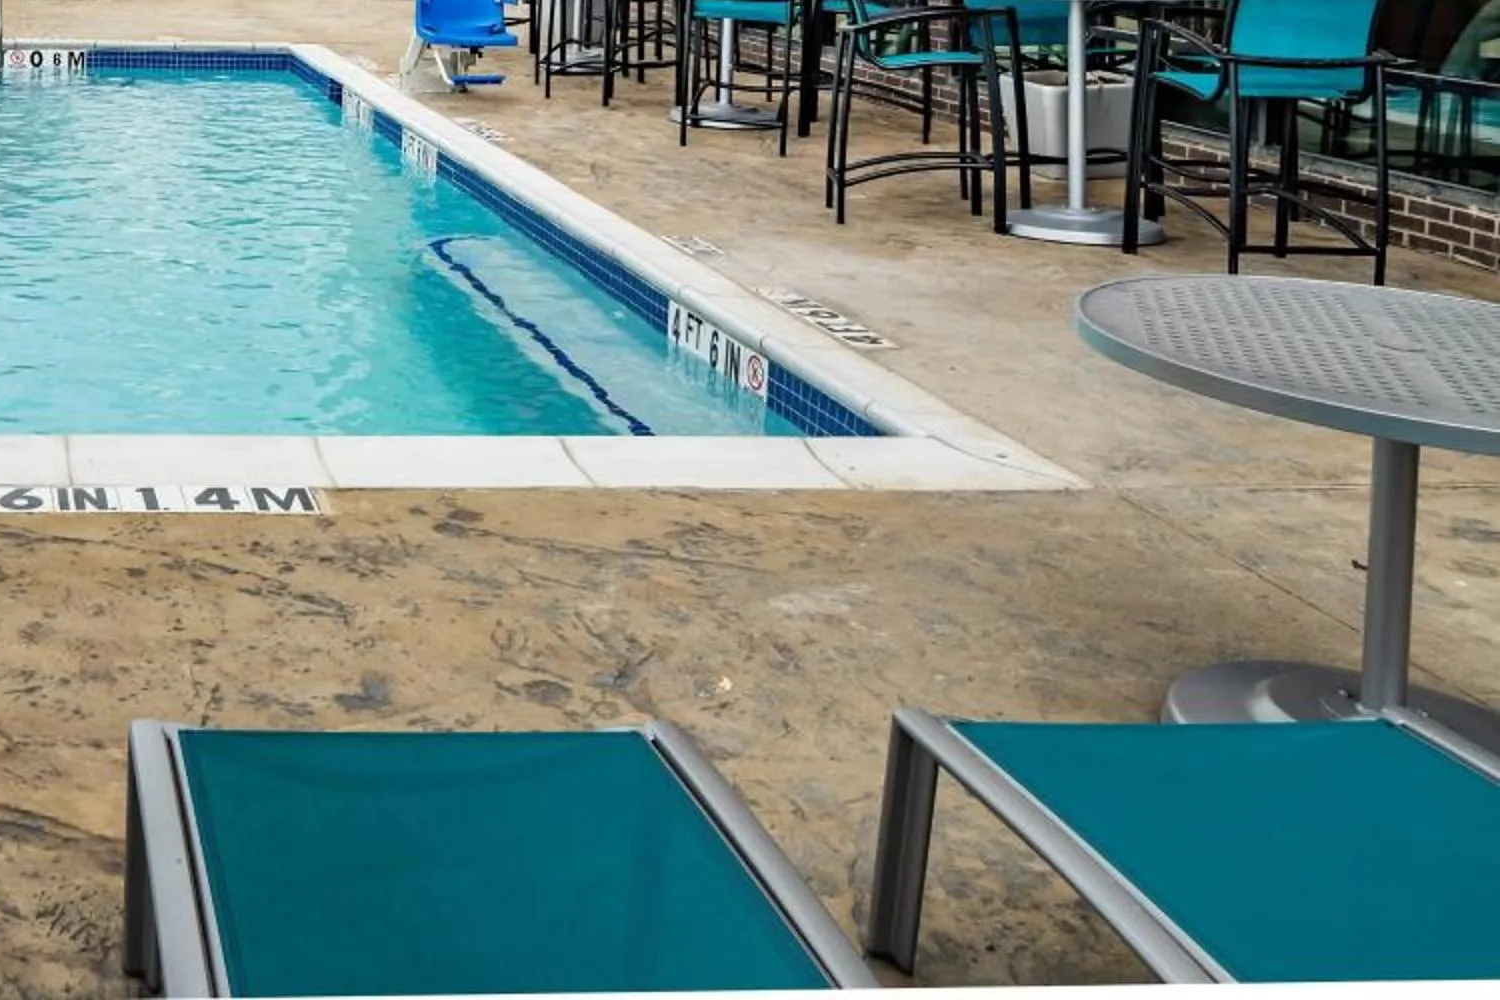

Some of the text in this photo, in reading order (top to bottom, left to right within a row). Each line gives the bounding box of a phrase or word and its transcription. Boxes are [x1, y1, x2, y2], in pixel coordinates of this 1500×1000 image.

[67, 51, 85, 72] M
[672, 308, 741, 385] 4 FT 6 IN
[251, 487, 315, 511] M
